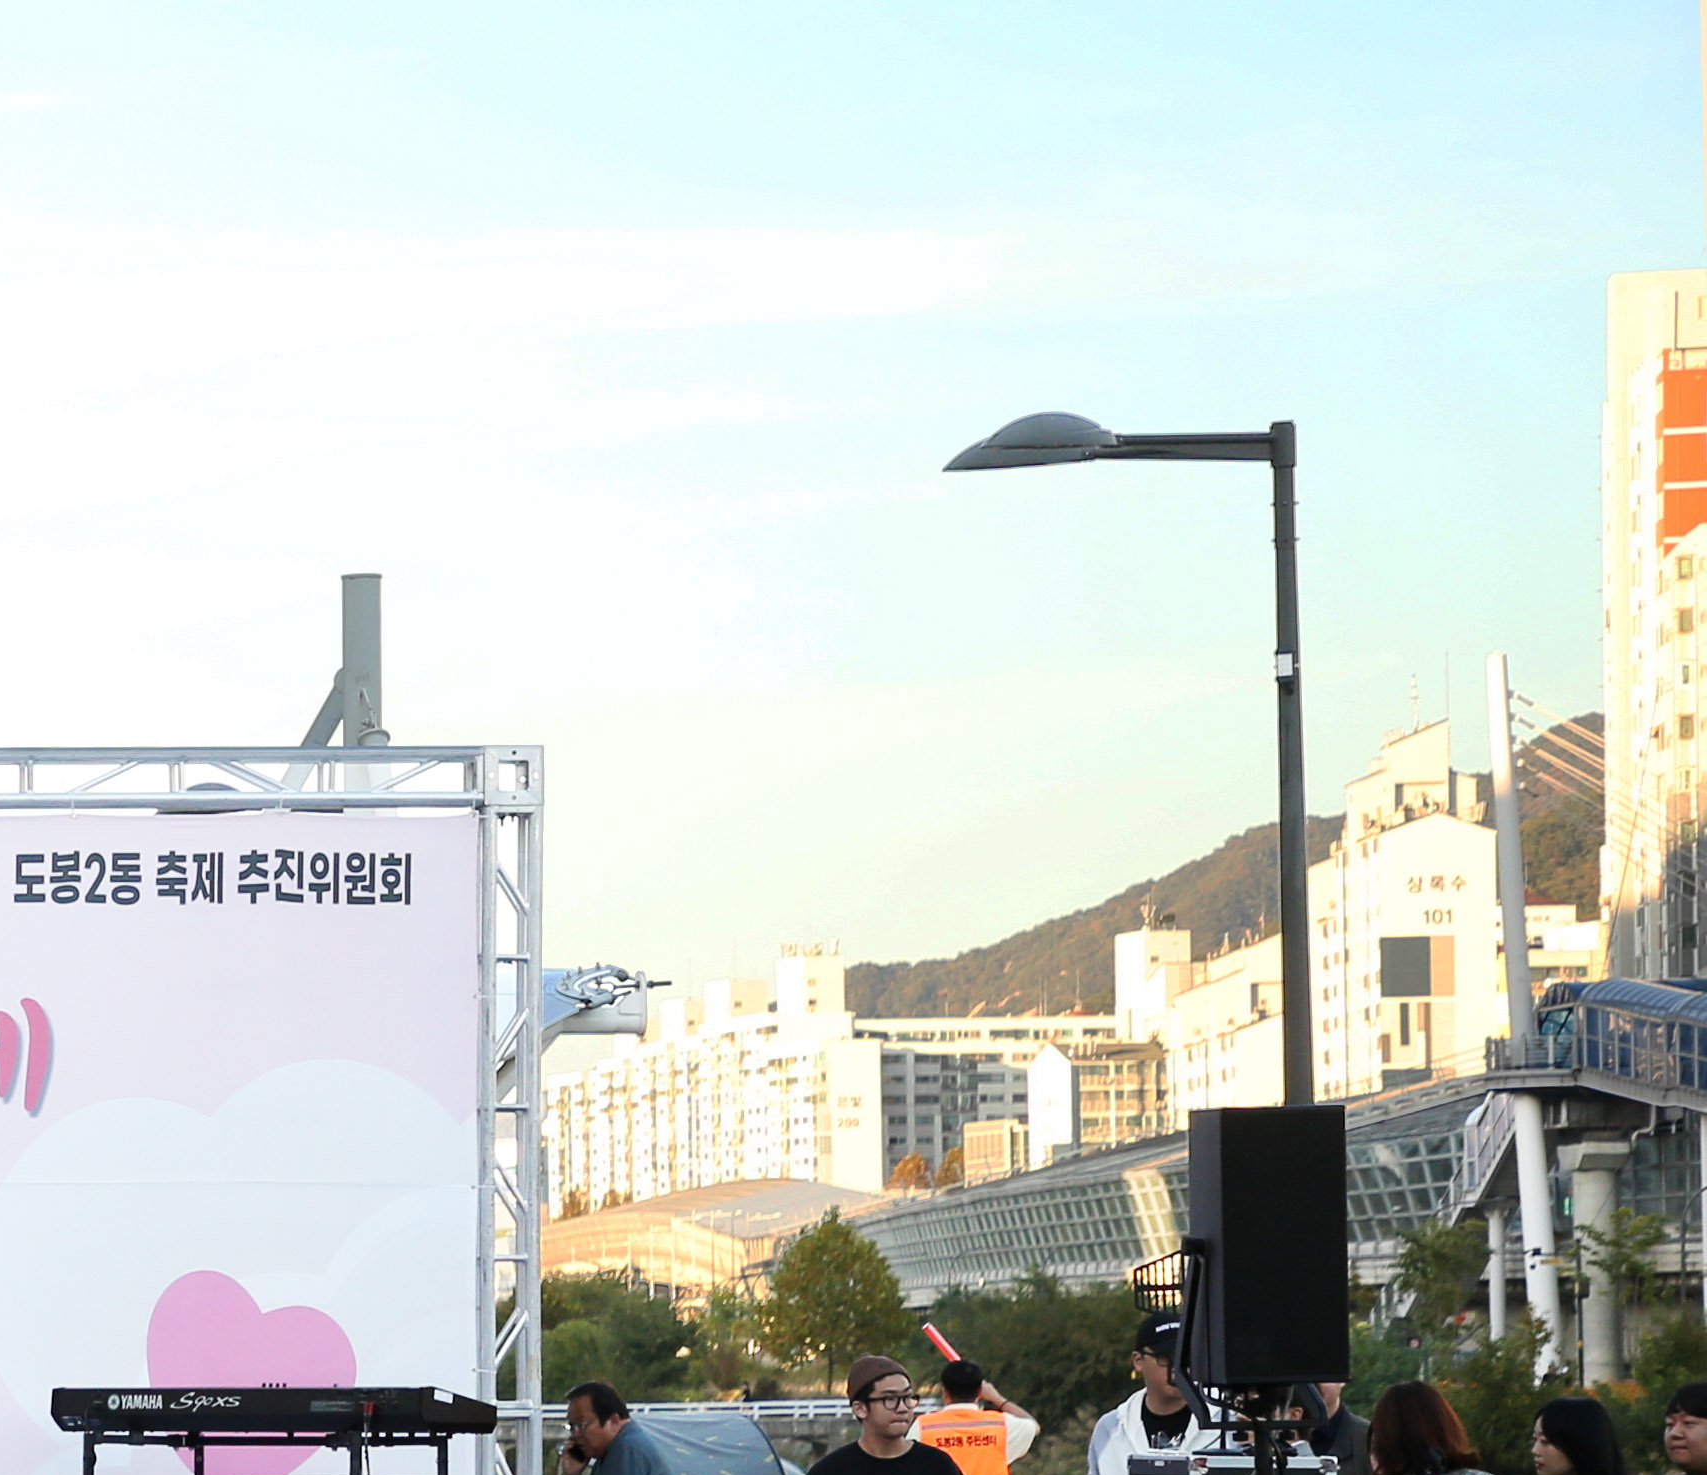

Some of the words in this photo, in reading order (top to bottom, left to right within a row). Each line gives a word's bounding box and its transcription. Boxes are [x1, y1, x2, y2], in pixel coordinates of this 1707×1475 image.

[13, 850, 143, 905] 도봉2동
[155, 850, 225, 906] 축제
[237, 848, 412, 906] 추진위원회
[1422, 908, 1453, 925] 101
[120, 1394, 163, 1410] YAMAHA
[935, 1435, 964, 1448] 도봉2동
[966, 1435, 997, 1448] 주민센터
